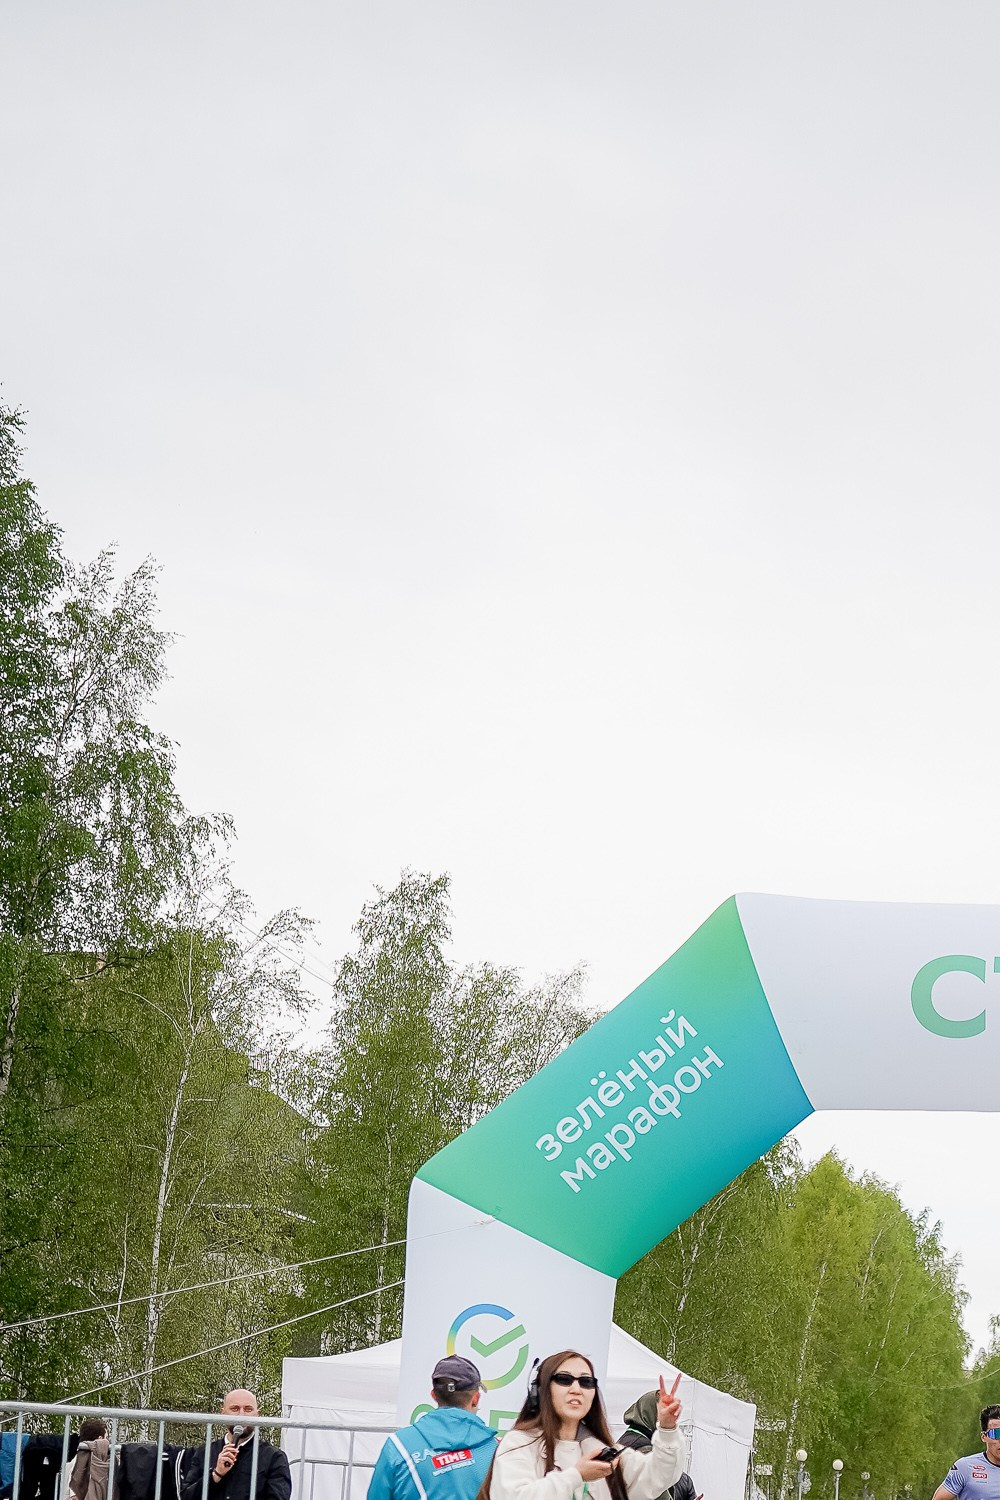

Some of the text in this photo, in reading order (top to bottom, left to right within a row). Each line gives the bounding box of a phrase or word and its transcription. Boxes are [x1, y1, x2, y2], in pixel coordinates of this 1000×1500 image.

[535, 1008, 698, 1161] зелёный
[559, 1045, 725, 1193] марафон
[435, 1450, 467, 1466] TIME
